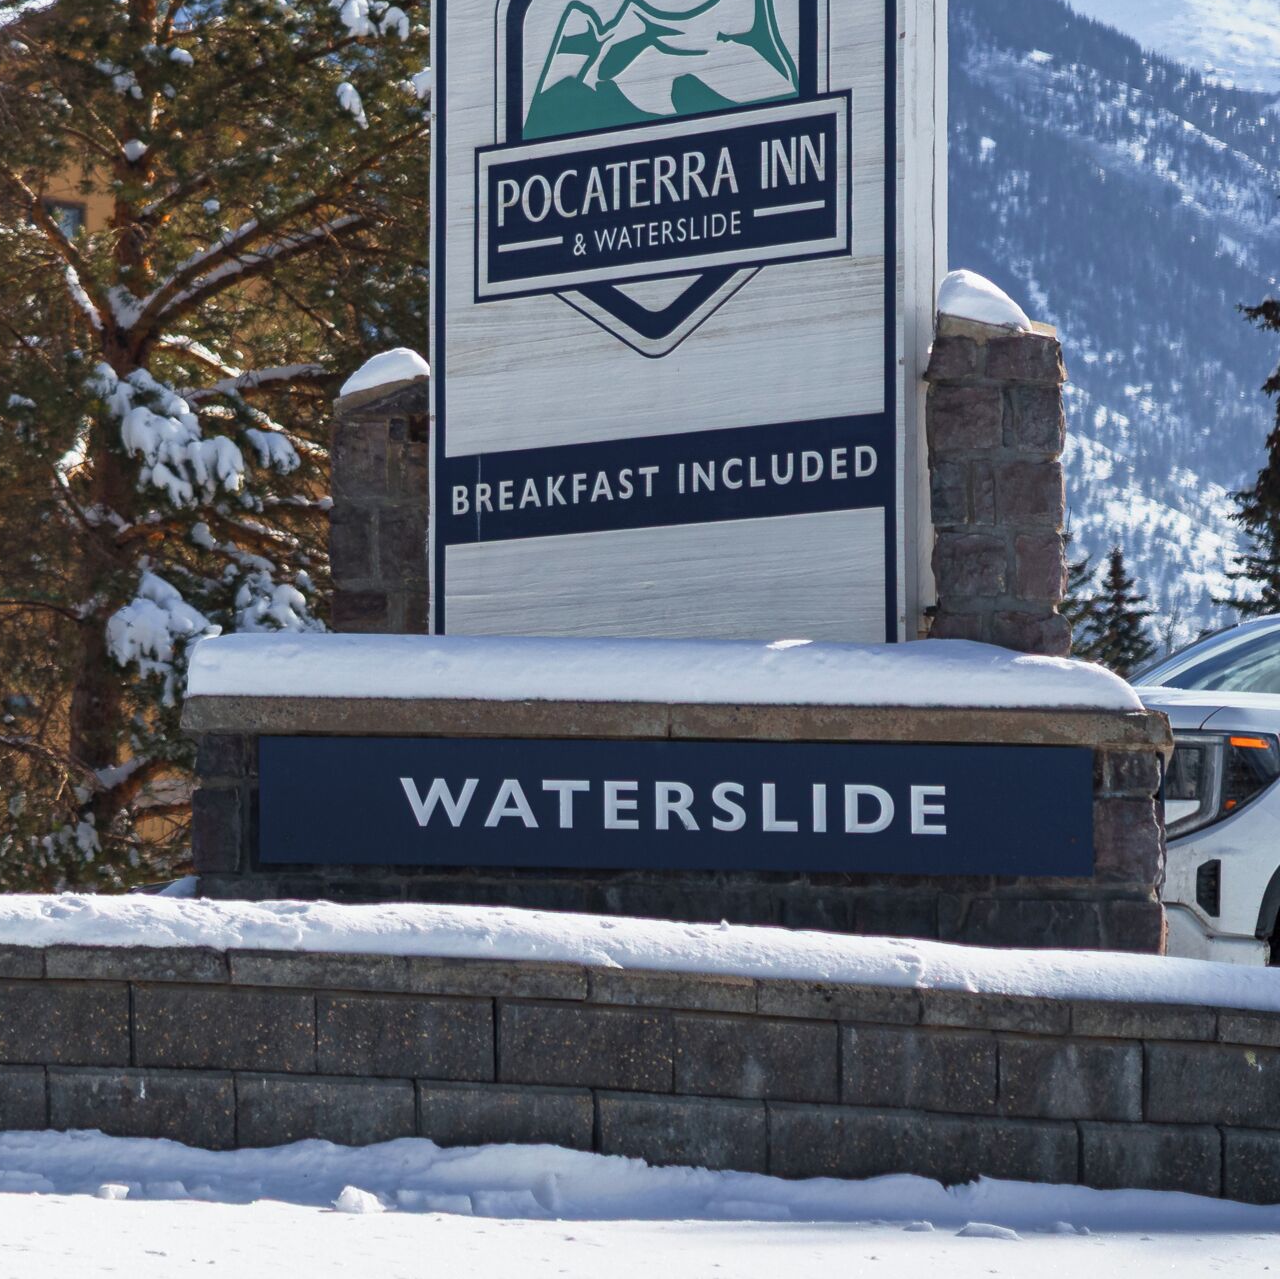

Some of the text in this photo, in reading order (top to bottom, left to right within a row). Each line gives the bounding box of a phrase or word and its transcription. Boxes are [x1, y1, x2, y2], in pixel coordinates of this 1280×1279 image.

[497, 132, 826, 227] POCATERRA INN
[572, 210, 742, 257] & WATERSLIDE
[452, 445, 878, 516] BREAKFAST INCLUDED
[399, 777, 947, 835] WATERSLIDE
